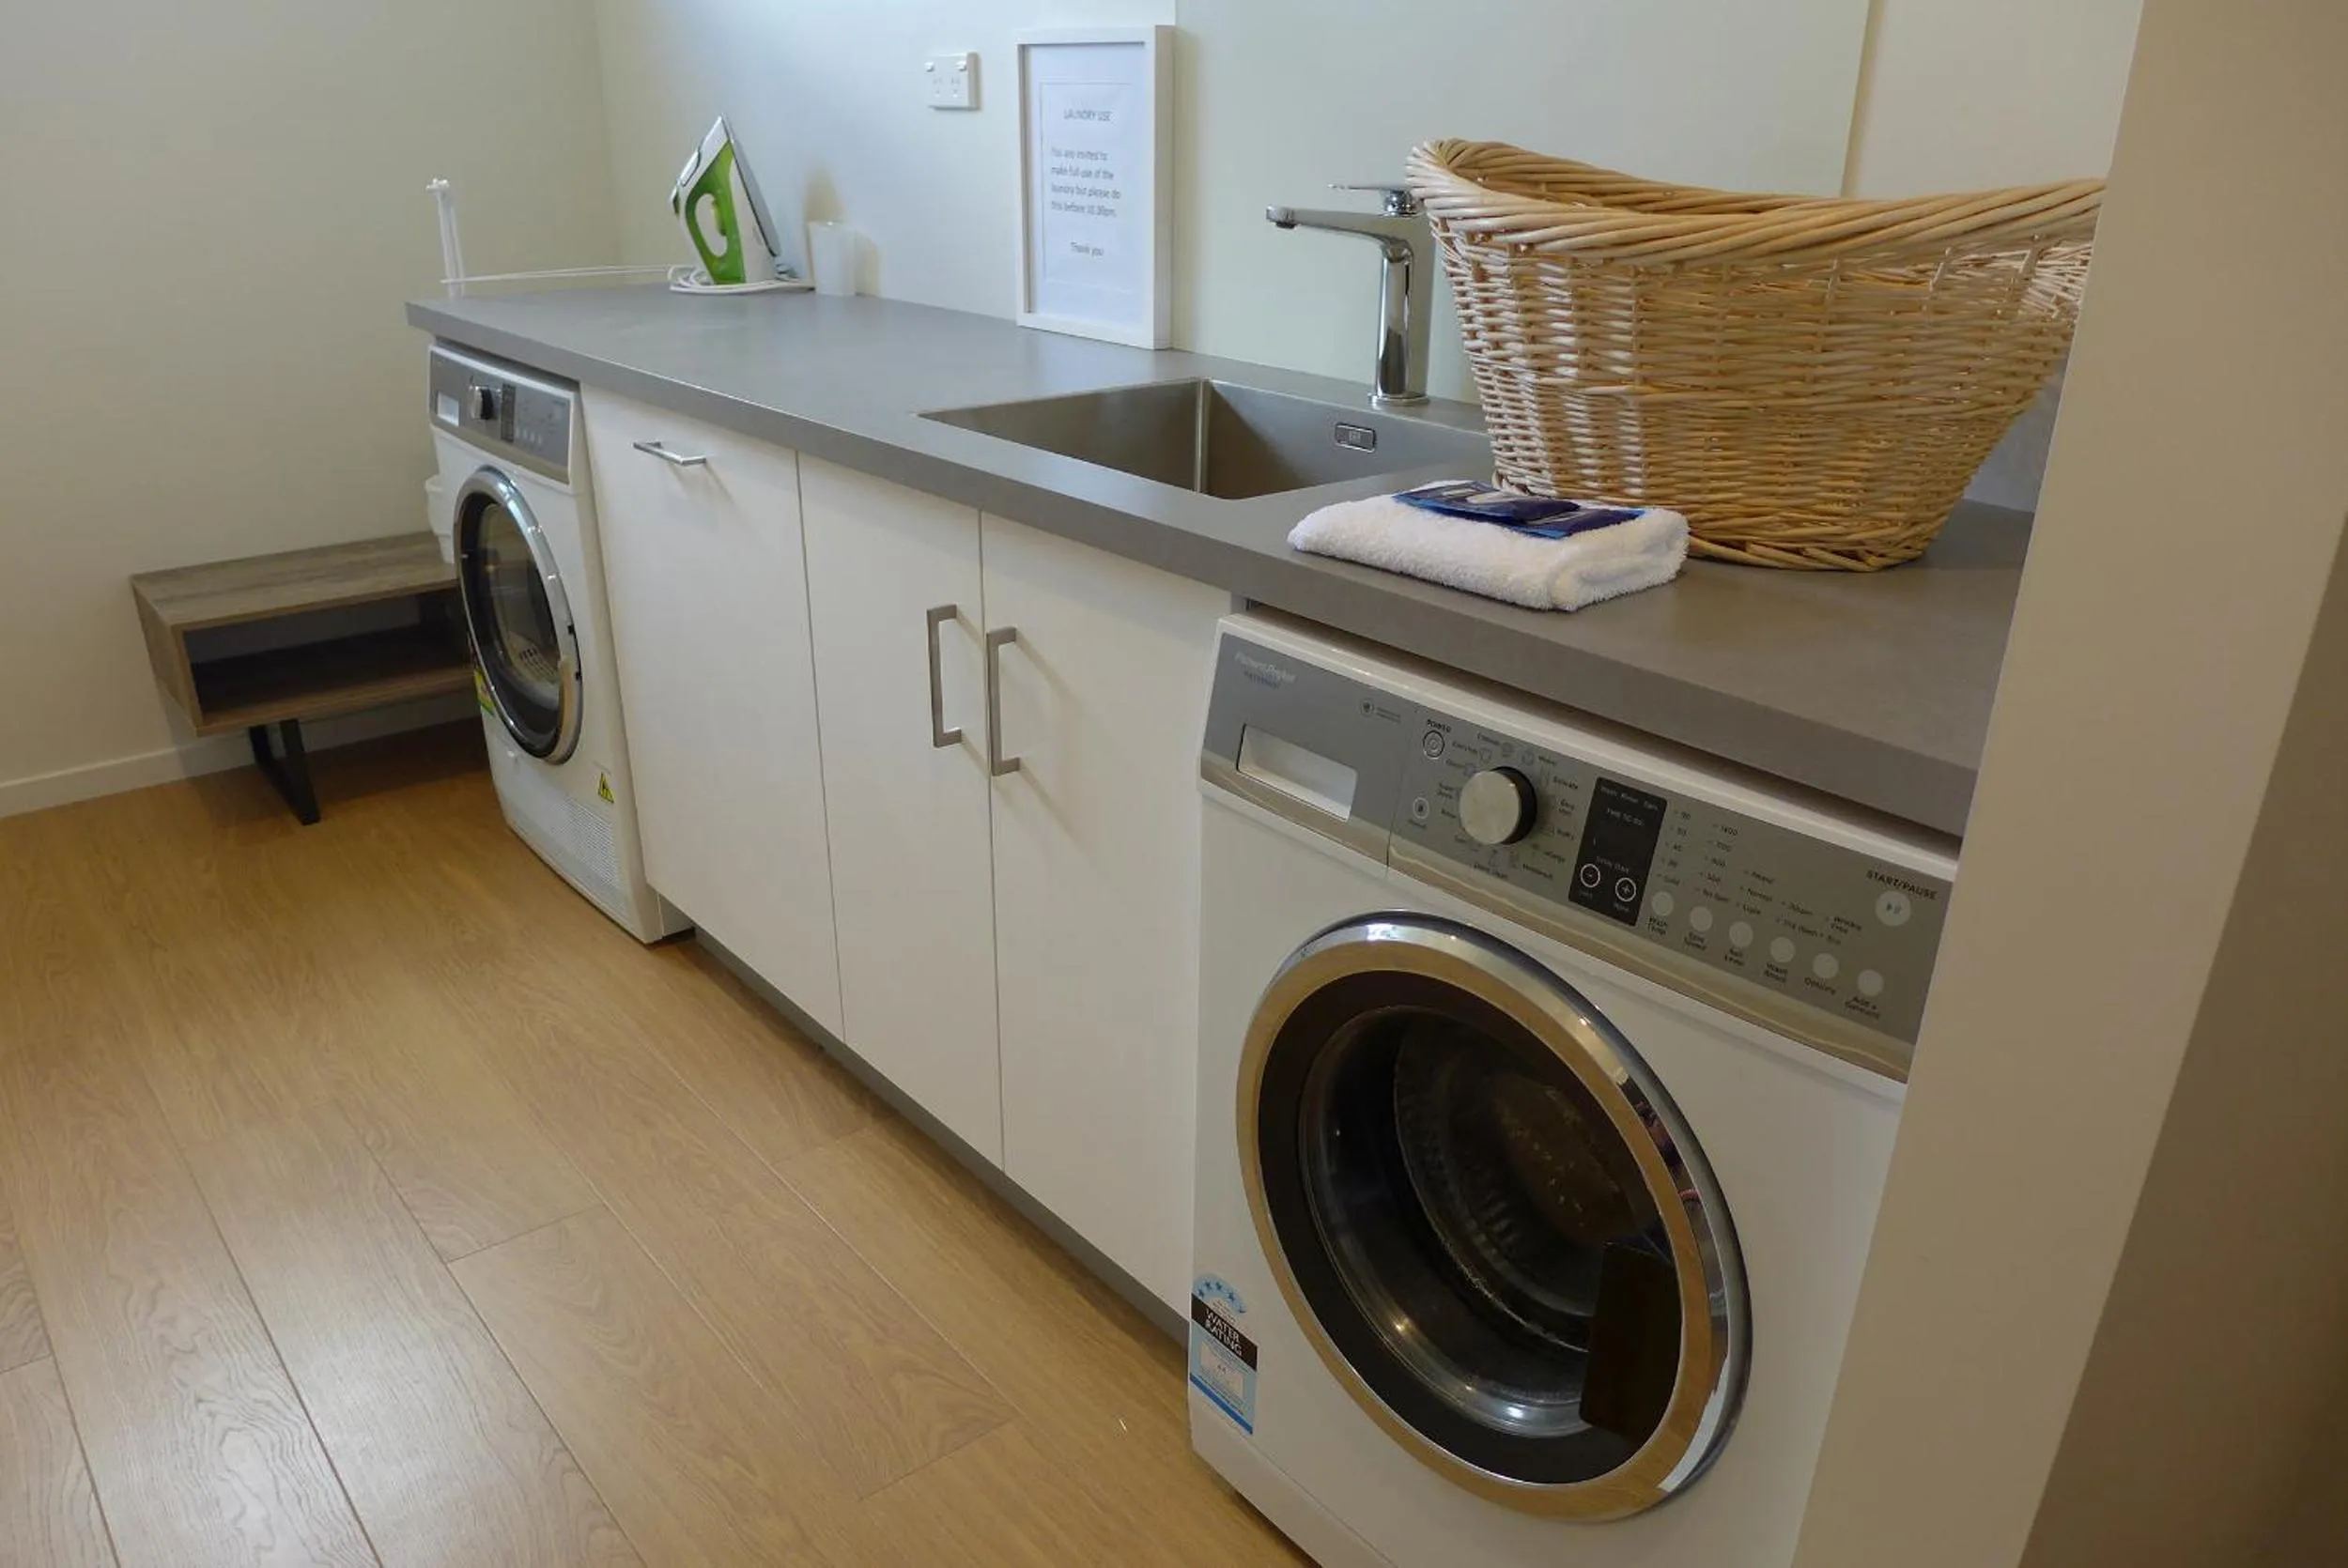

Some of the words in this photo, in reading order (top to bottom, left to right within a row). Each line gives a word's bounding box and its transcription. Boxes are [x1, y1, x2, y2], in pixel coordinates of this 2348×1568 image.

[1063, 108, 1095, 121] LAUNDRY
[1097, 111, 1112, 122] USE
[1076, 149, 1099, 161] invited
[1051, 165, 1068, 177] make
[1069, 164, 1080, 177] full
[1081, 170, 1092, 178] use
[1102, 169, 1114, 180] the
[1075, 184, 1087, 195] but
[1089, 187, 1110, 199] please
[1111, 189, 1121, 200] do
[1064, 201, 1085, 213] before
[1070, 241, 1090, 254] Thank
[1091, 247, 1104, 257] you
[1865, 869, 1939, 900] START/PAUSE
[1205, 1307, 1240, 1344] WATER
[1204, 1318, 1243, 1357] RATING
